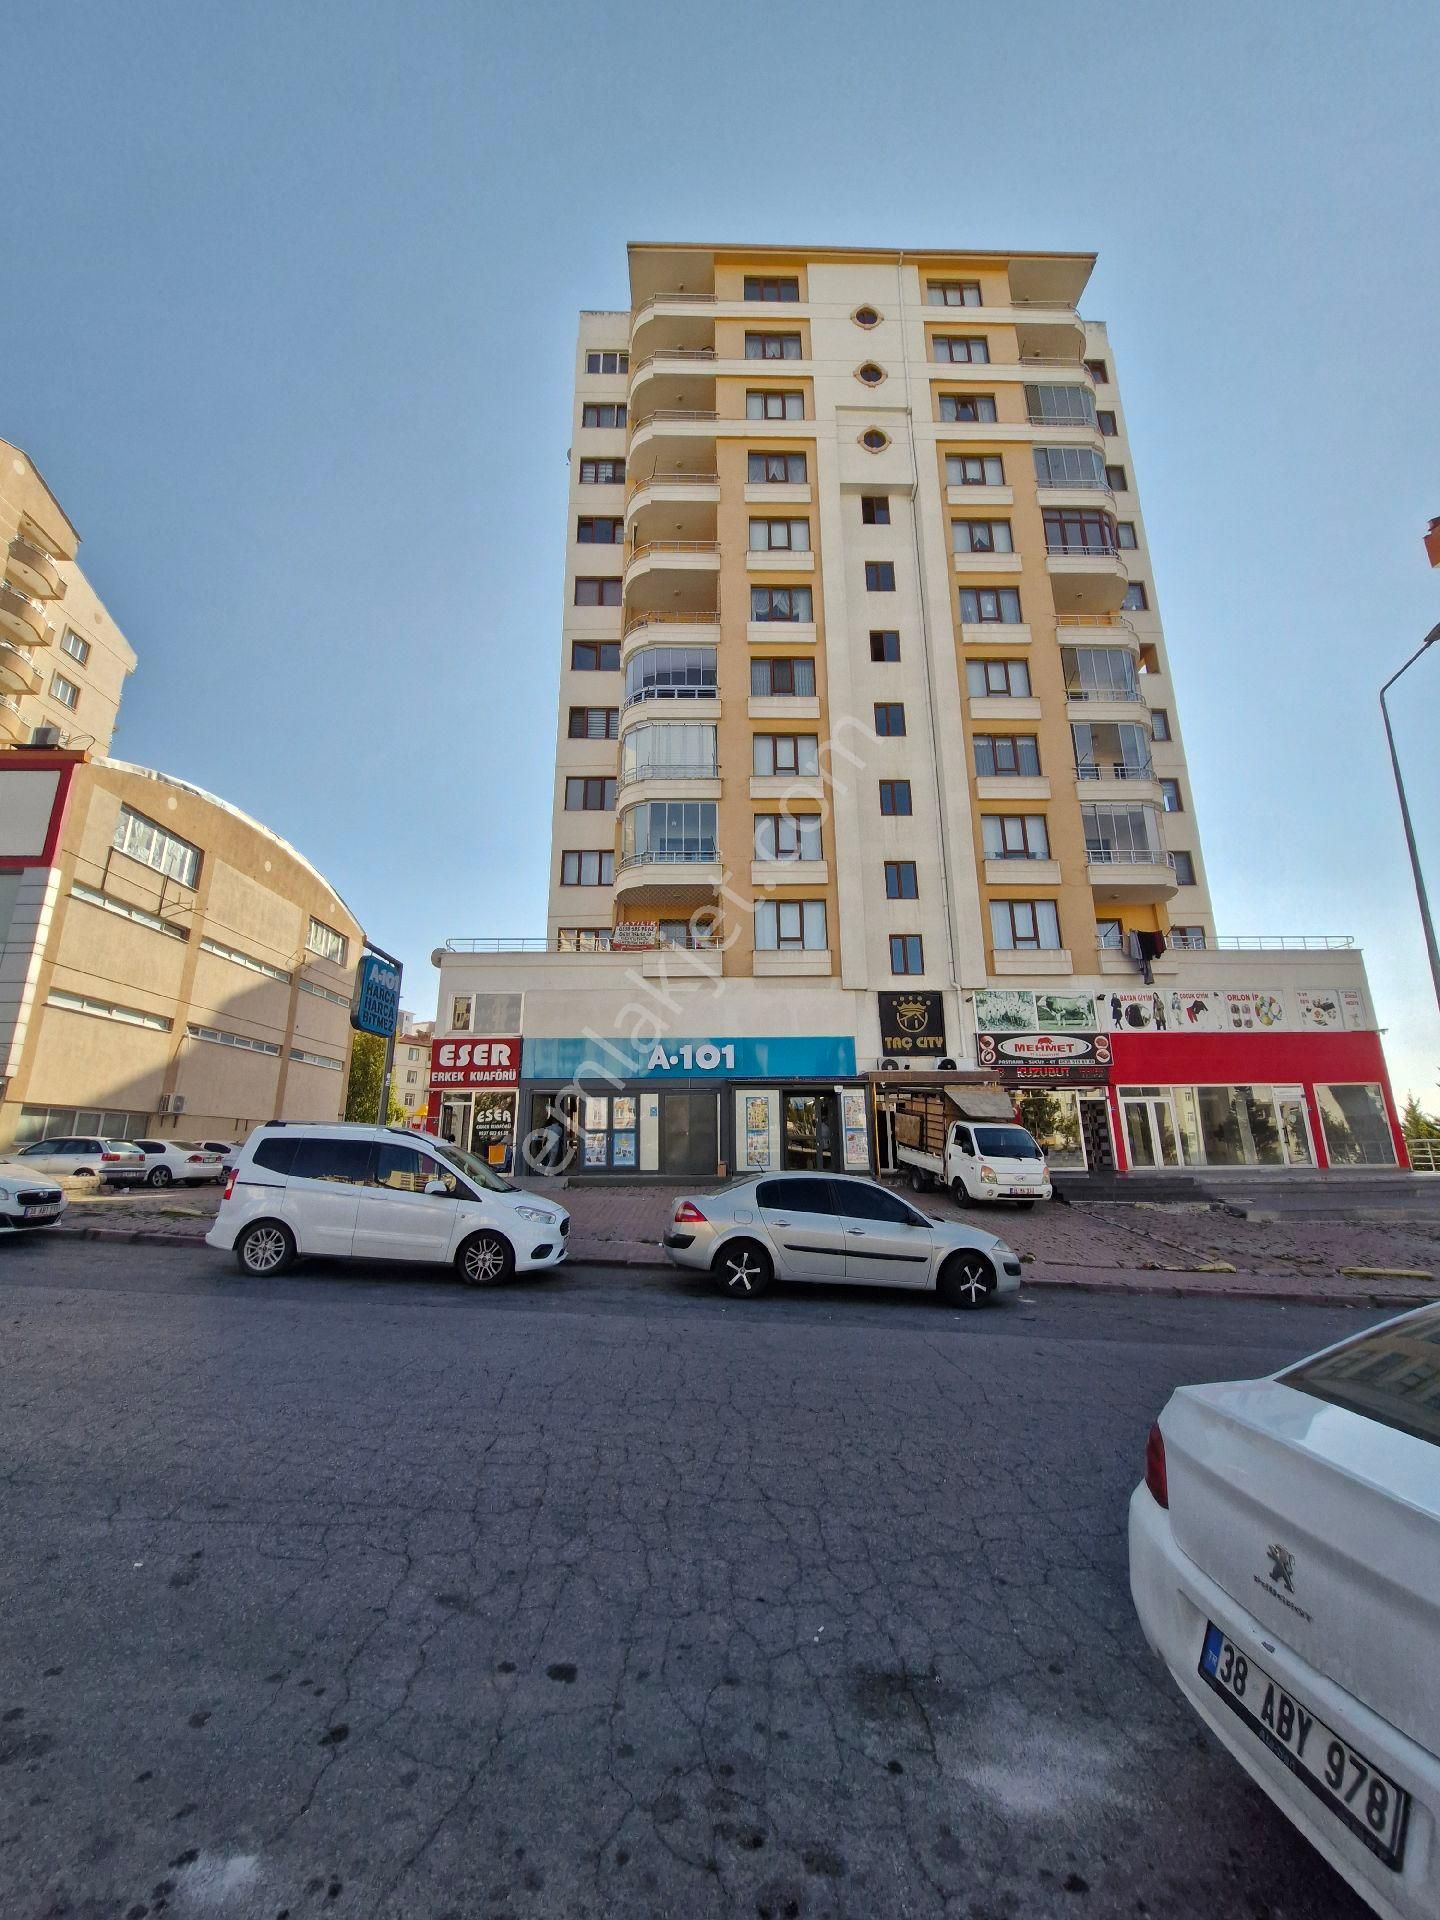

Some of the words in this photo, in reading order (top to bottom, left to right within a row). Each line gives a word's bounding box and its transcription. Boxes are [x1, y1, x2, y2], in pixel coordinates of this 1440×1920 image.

[367, 982, 396, 1007] HARCA
[364, 996, 394, 1020] HARCA
[885, 1036, 913, 1051] TAÇ
[916, 1036, 943, 1048] CITY
[1014, 1043, 1074, 1053] MEHMET
[439, 1044, 511, 1067] ESER
[432, 1072, 464, 1082] ERKEK
[469, 1068, 517, 1081] KUAFÖRÜ
[477, 1108, 511, 1122] ESER
[1208, 1650, 1218, 1665] TR
[1220, 1644, 1248, 1697] 38
[1262, 1682, 1313, 1758] ABY
[1325, 1741, 1388, 1831] 978
